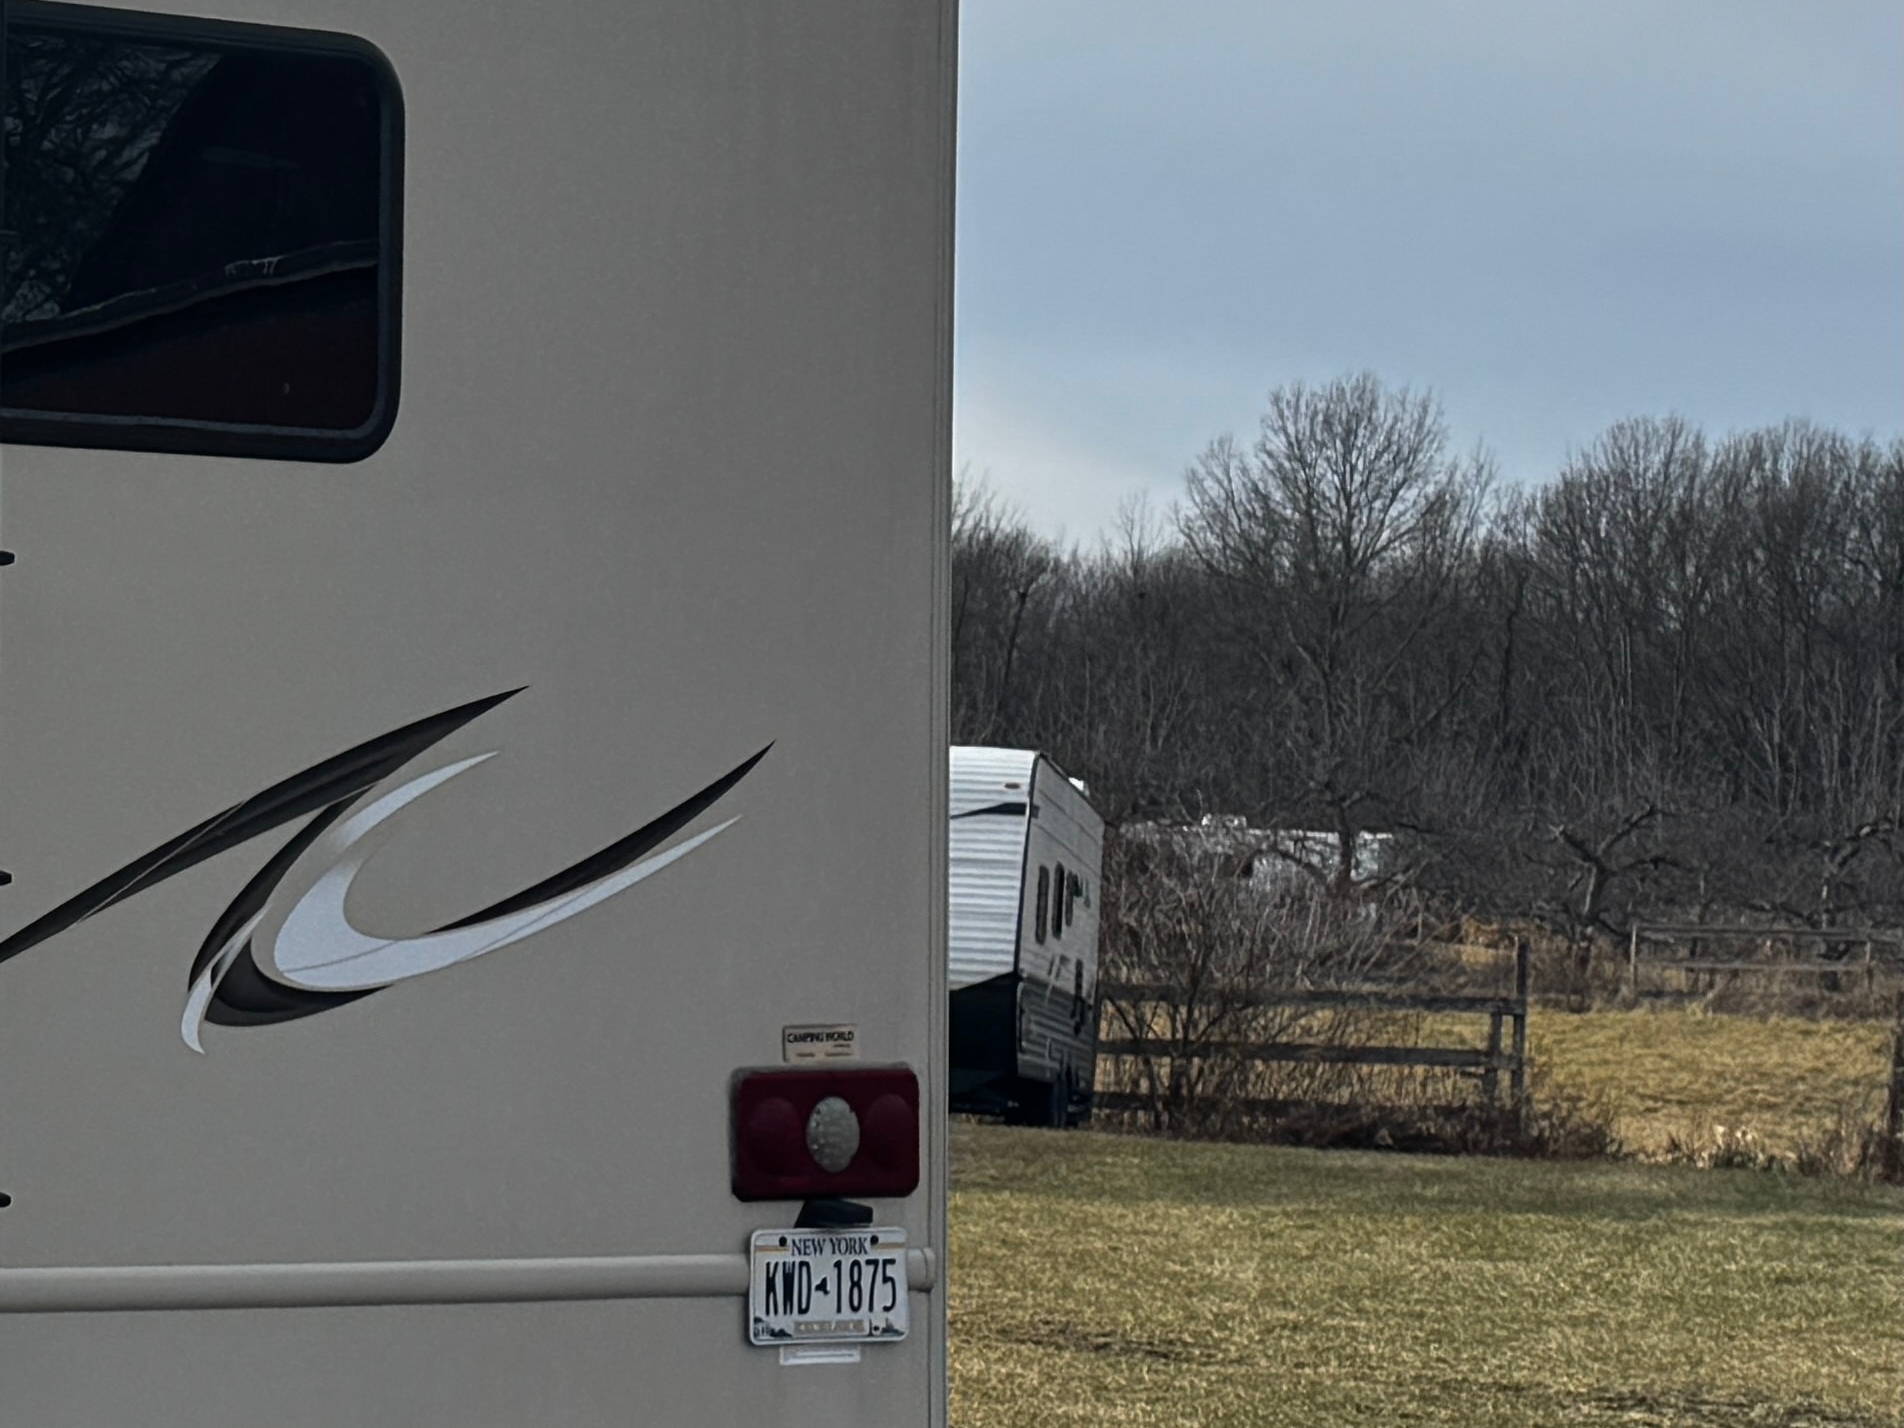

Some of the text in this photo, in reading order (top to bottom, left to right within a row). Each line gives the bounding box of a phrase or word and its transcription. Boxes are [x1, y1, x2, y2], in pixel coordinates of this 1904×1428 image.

[787, 1031, 854, 1043] CAMPING WORLD
[791, 1236, 868, 1256] NEW YORK
